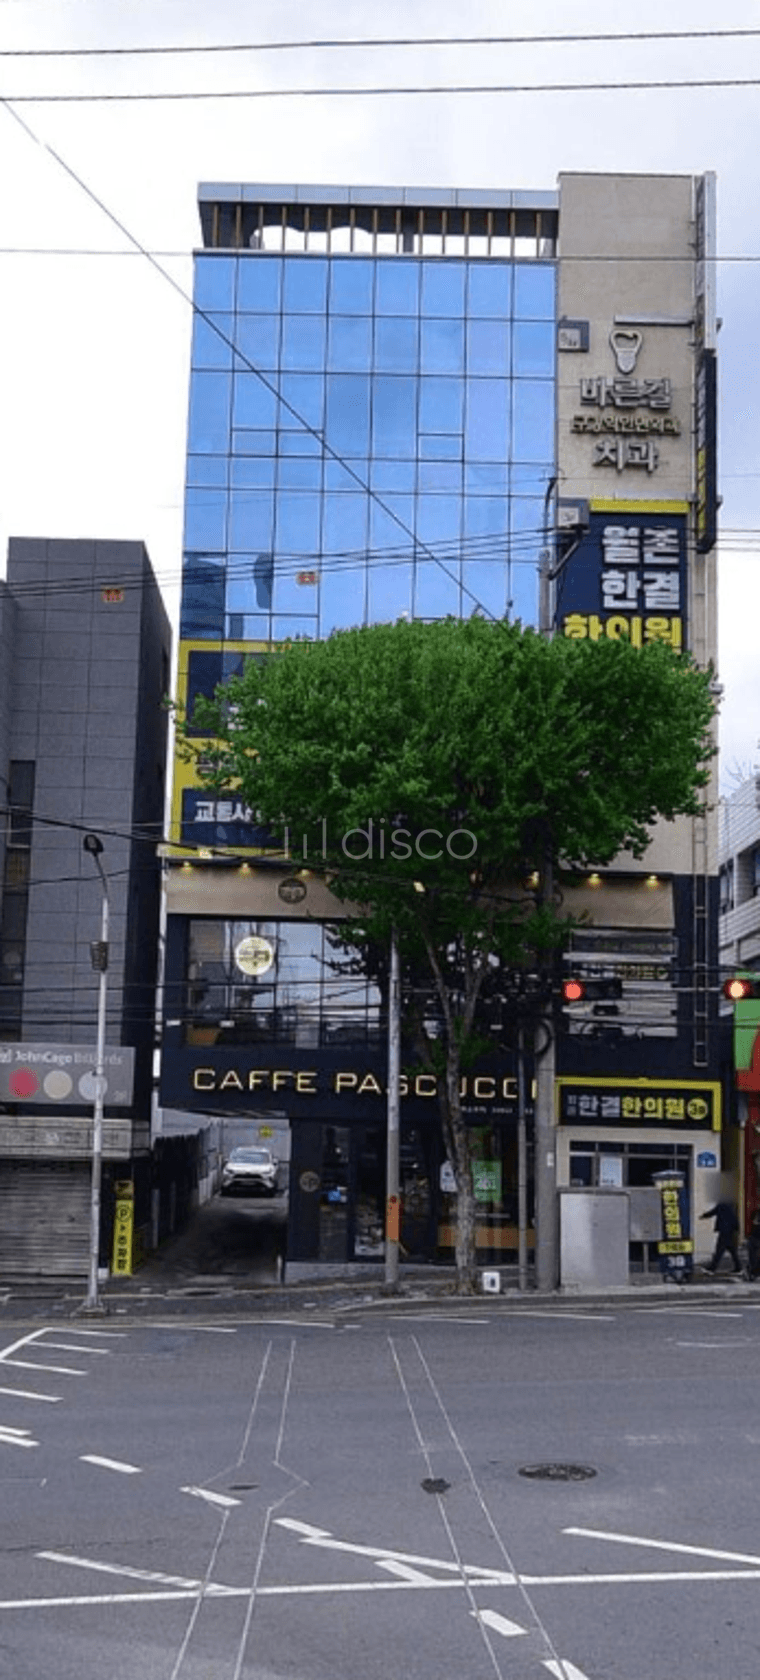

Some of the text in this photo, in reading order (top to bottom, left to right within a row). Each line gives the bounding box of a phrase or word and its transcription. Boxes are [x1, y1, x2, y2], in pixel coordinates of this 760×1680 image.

[580, 378, 671, 410] 바른길
[595, 441, 659, 472] 치과
[602, 570, 680, 610] 한결
[194, 801, 262, 822] 교통사
[193, 1068, 318, 1092] CAFFE
